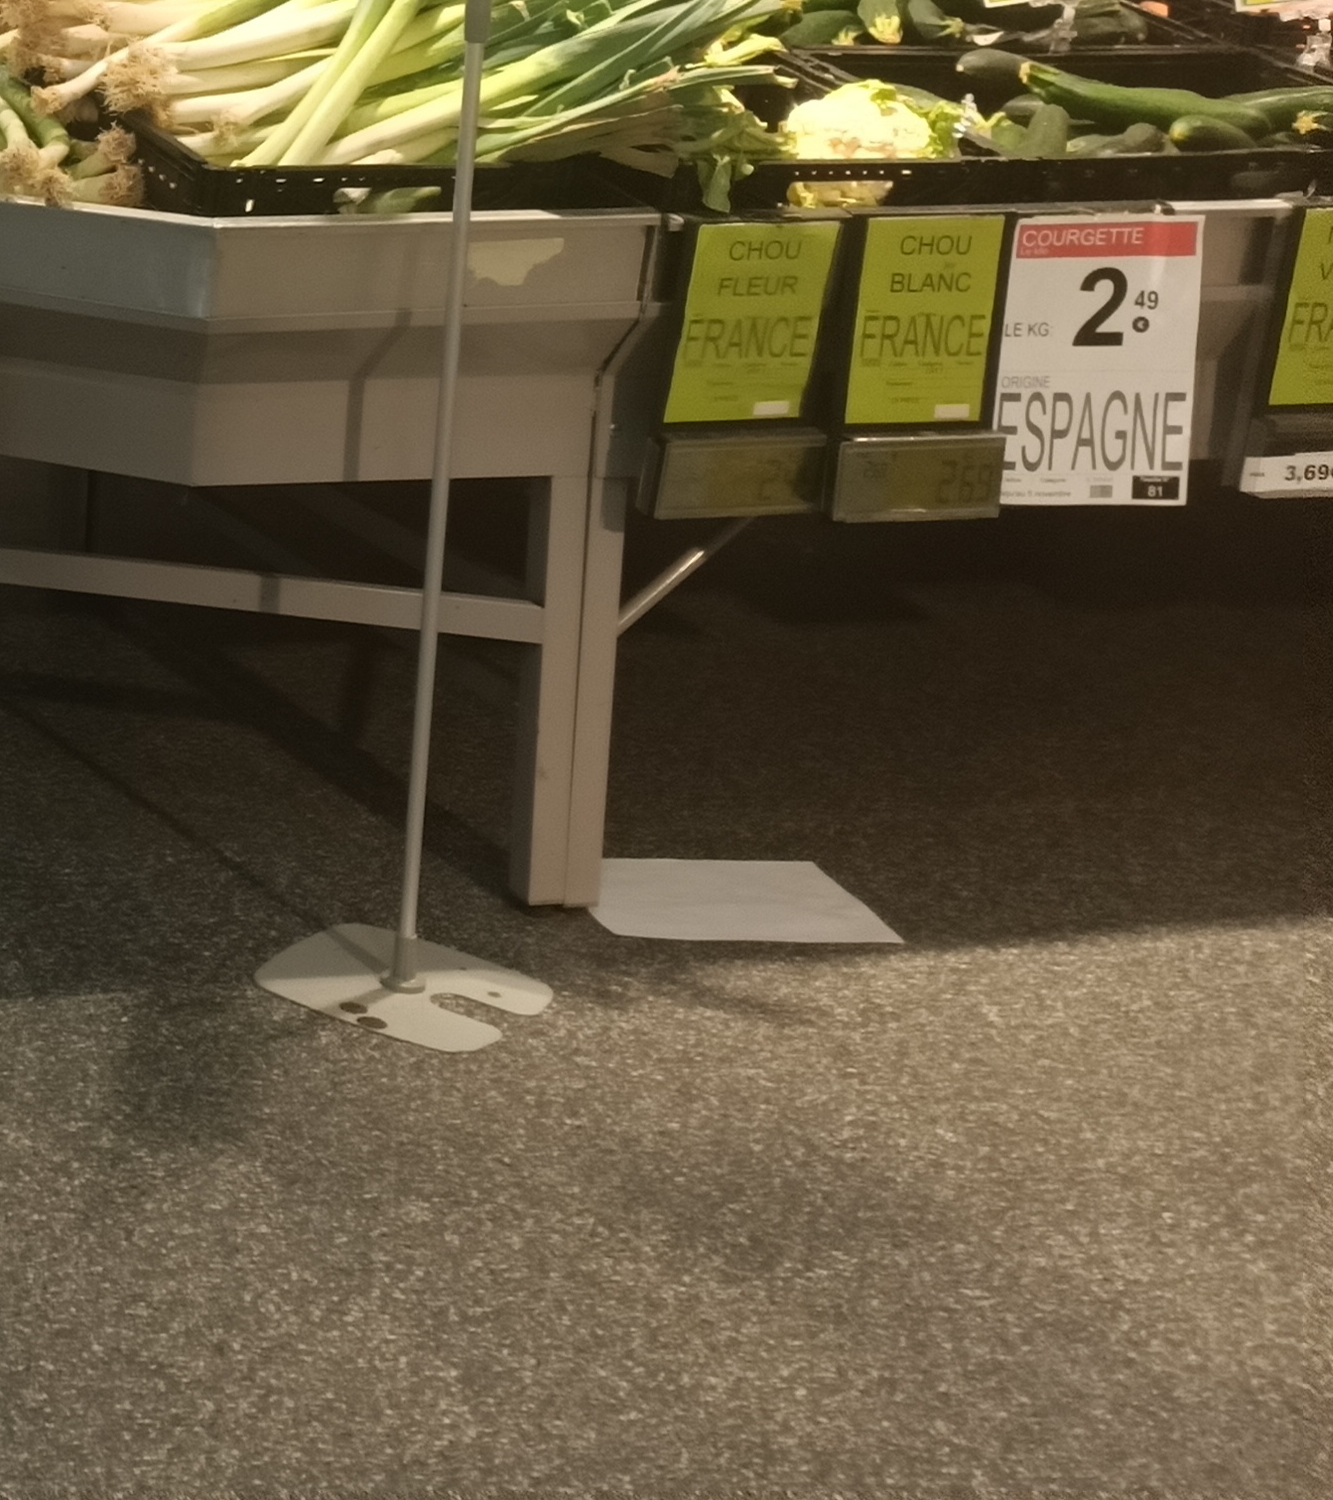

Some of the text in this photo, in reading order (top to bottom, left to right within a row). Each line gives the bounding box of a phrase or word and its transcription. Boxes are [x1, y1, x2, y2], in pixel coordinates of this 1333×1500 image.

[899, 235, 974, 256] CHOU
[1022, 227, 1145, 247] COURGETTE
[728, 240, 803, 261] CHOU
[716, 276, 799, 298] FLEUR
[889, 272, 973, 294] BLANC
[683, 314, 814, 360] FRANCE
[860, 313, 988, 360] FRANCE
[1004, 323, 1023, 337] LE
[1001, 375, 1050, 389] ORIGINE
[996, 389, 1187, 473] ESPAGNE
[1147, 485, 1163, 498] 81
